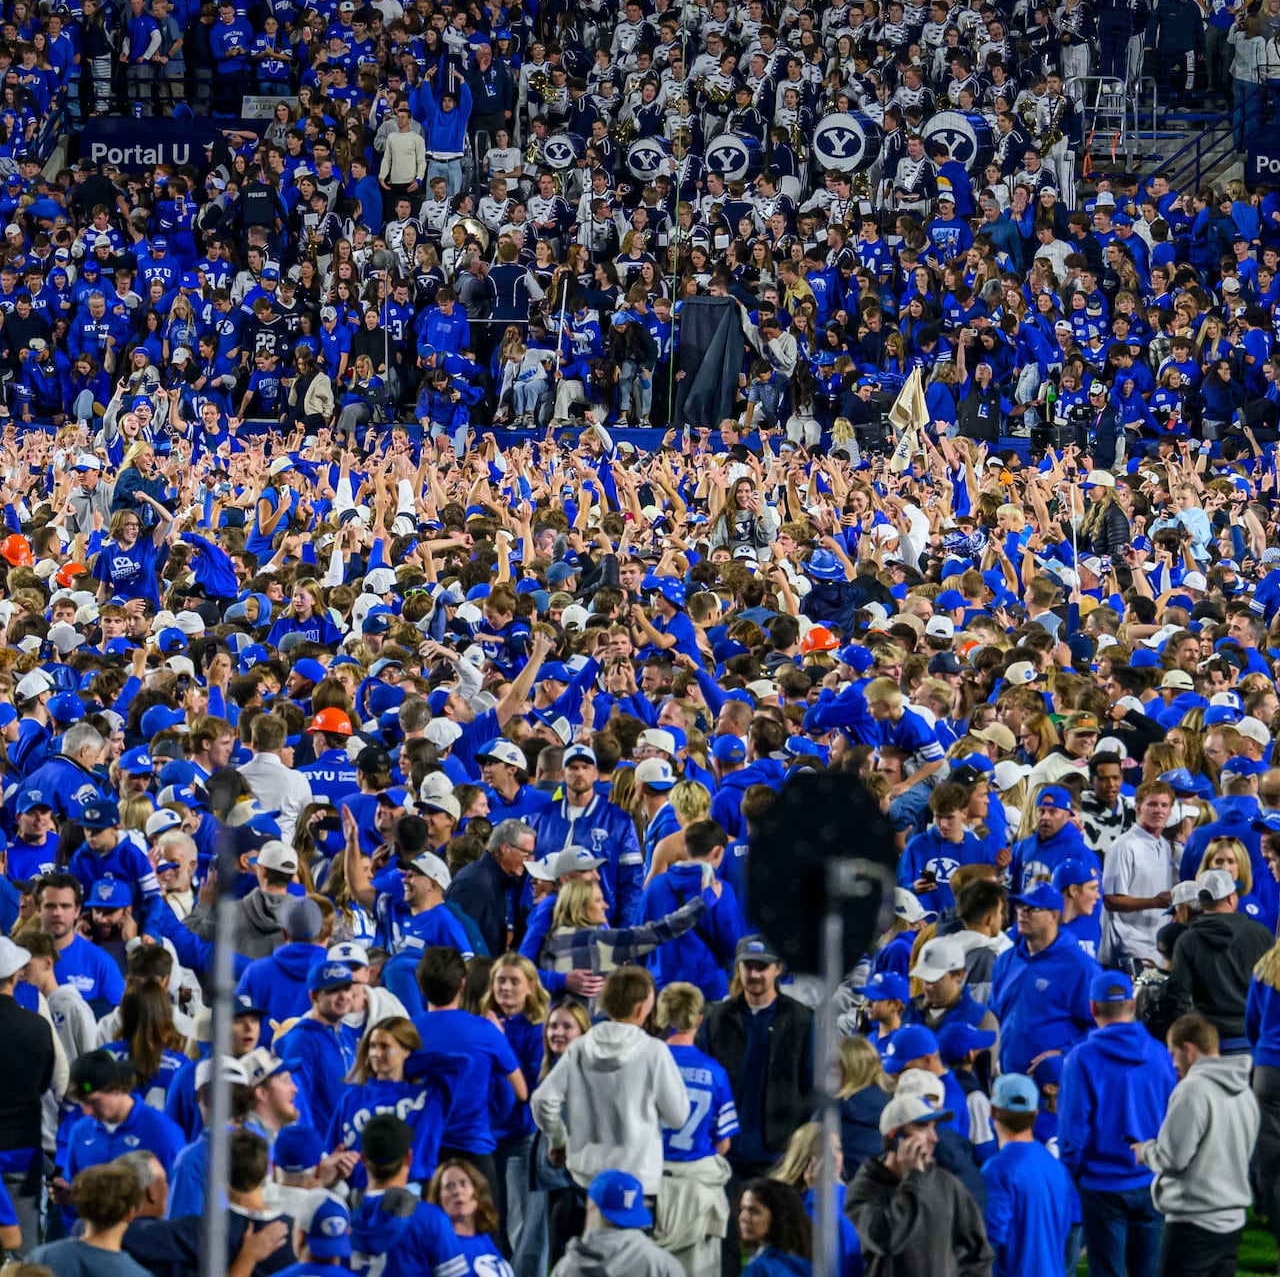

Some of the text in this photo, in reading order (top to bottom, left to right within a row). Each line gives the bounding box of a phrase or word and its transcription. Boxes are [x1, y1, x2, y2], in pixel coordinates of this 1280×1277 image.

[91, 143, 190, 165] Portal U
[247, 190, 268, 199] POLICE
[144, 268, 171, 279] BYU
[255, 333, 277, 353] 22
